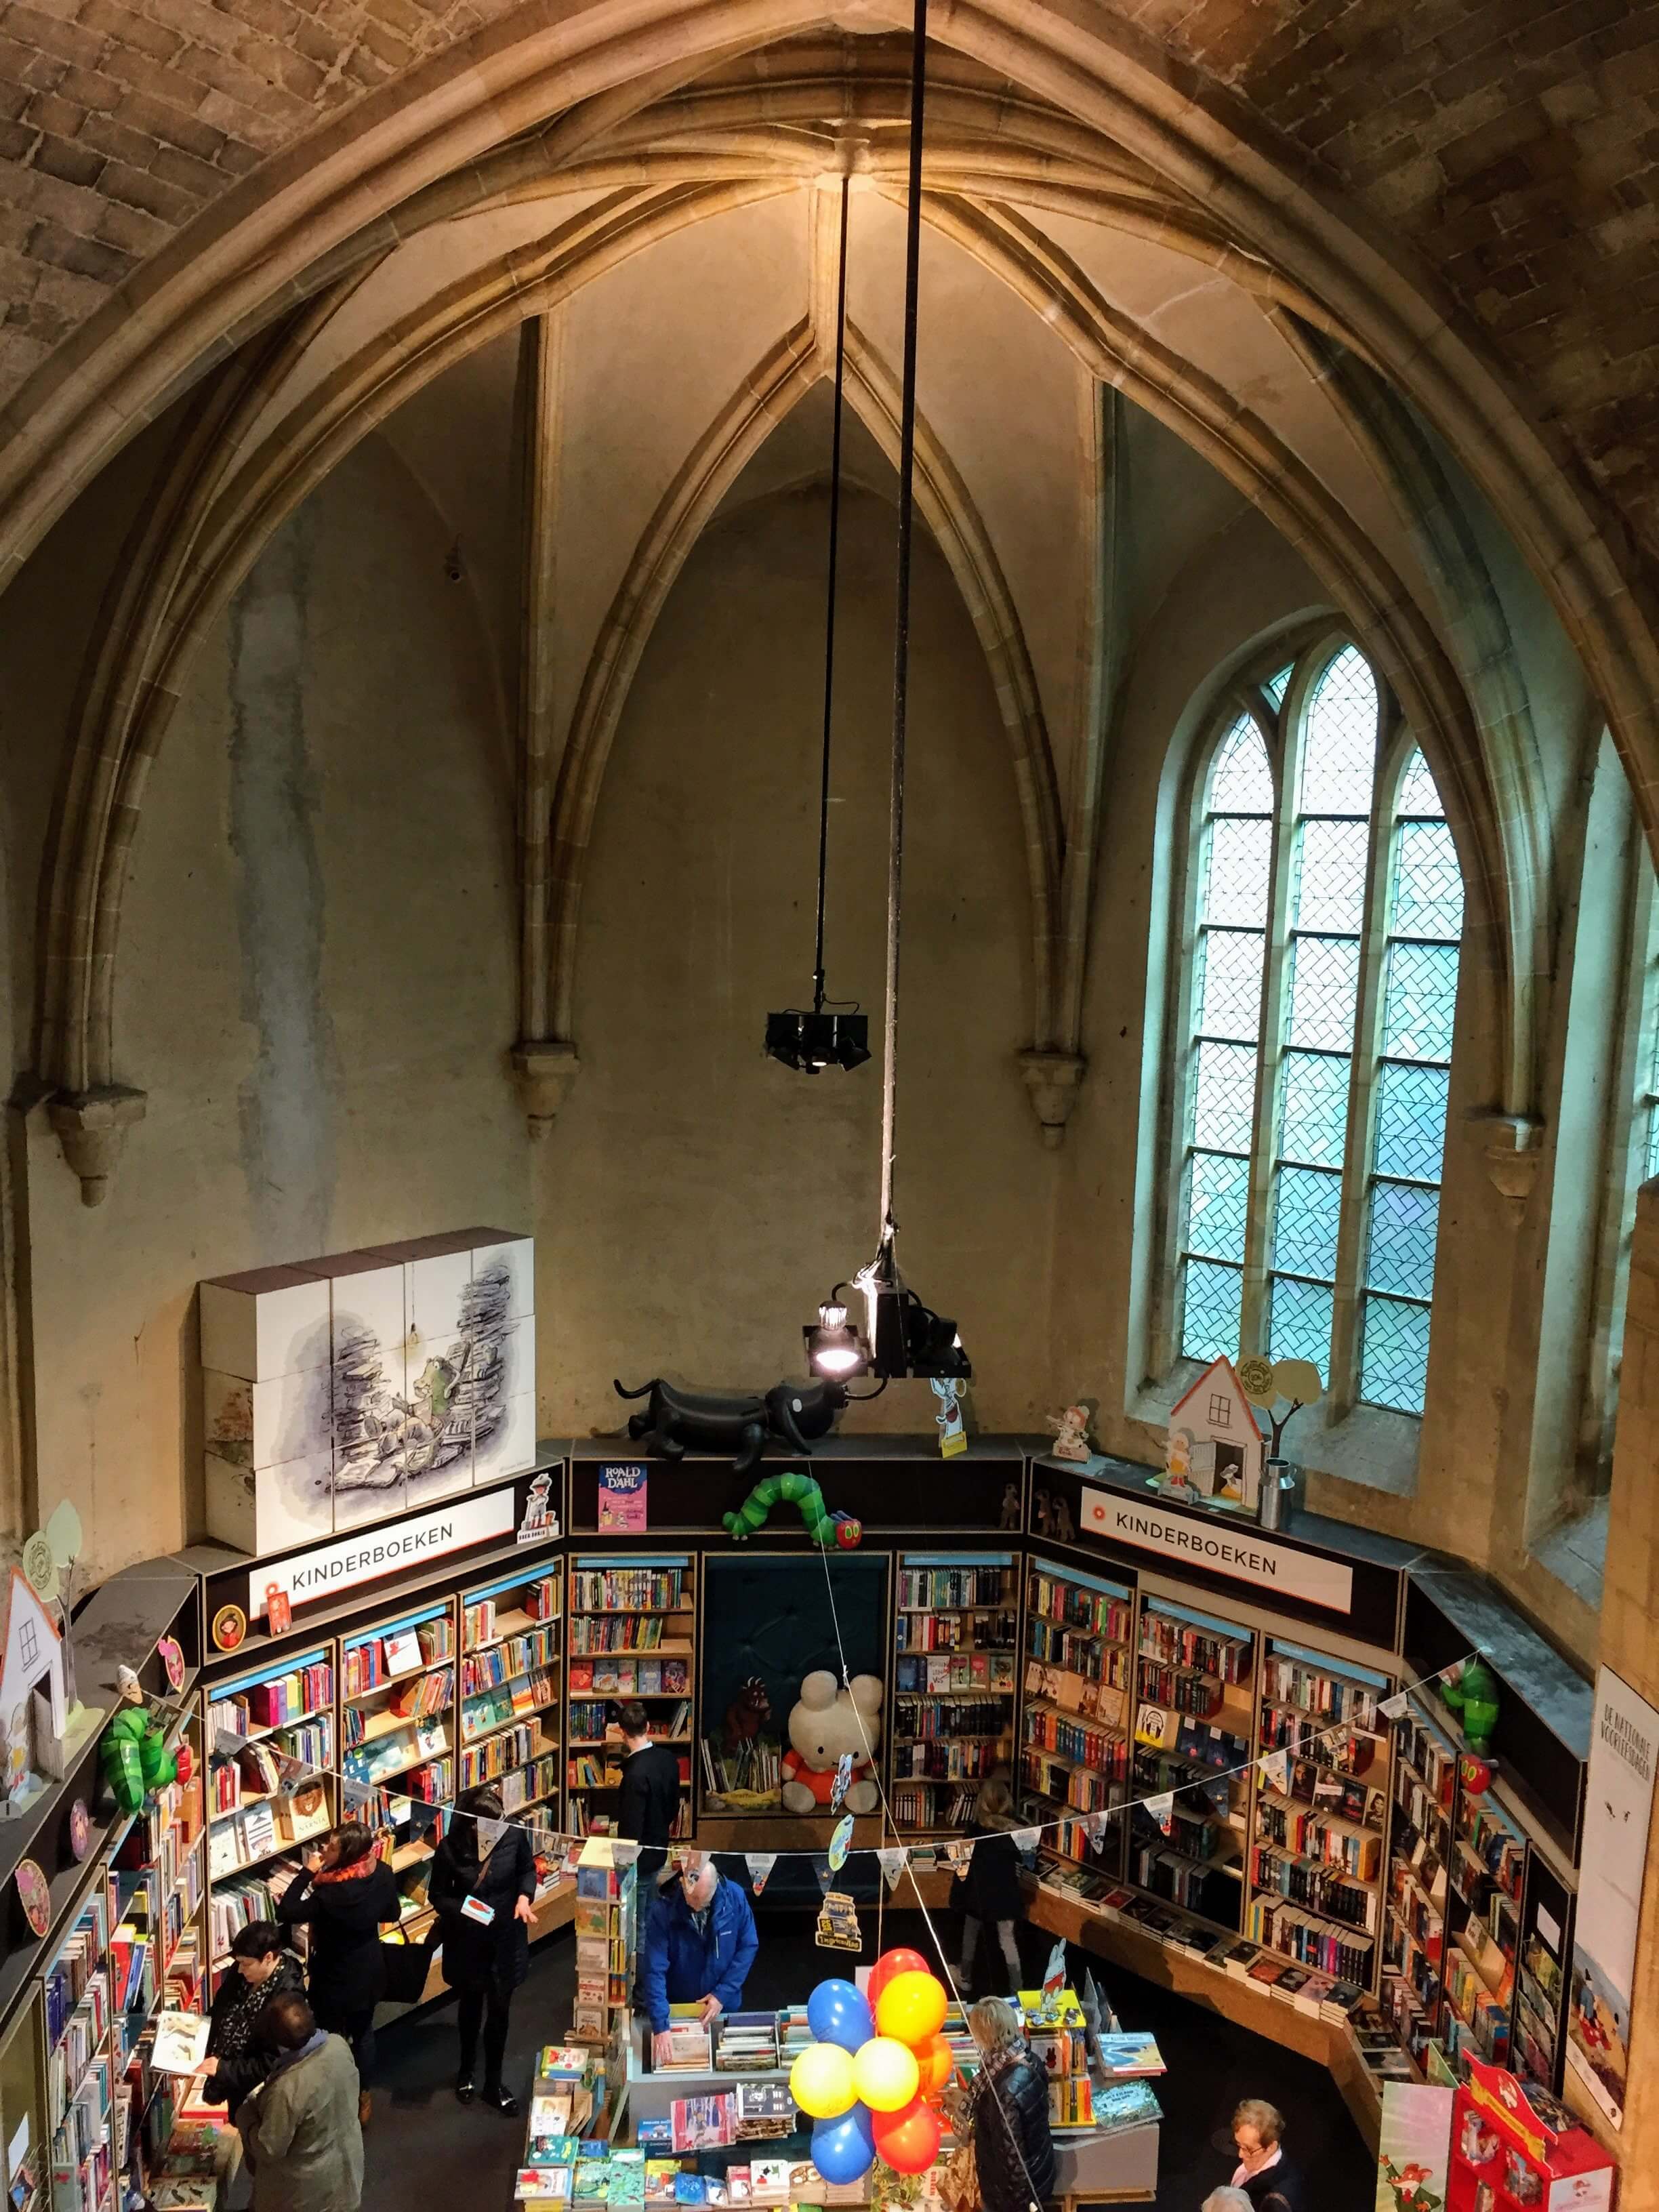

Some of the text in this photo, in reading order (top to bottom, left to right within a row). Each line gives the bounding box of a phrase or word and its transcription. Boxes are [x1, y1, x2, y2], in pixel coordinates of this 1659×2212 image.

[605, 1467, 640, 1479] ROALD
[608, 1477, 638, 1489] DAHL
[292, 1523, 453, 1591] KINDERBOEKEN
[1116, 1512, 1277, 1576] KINDERBOEKEN
